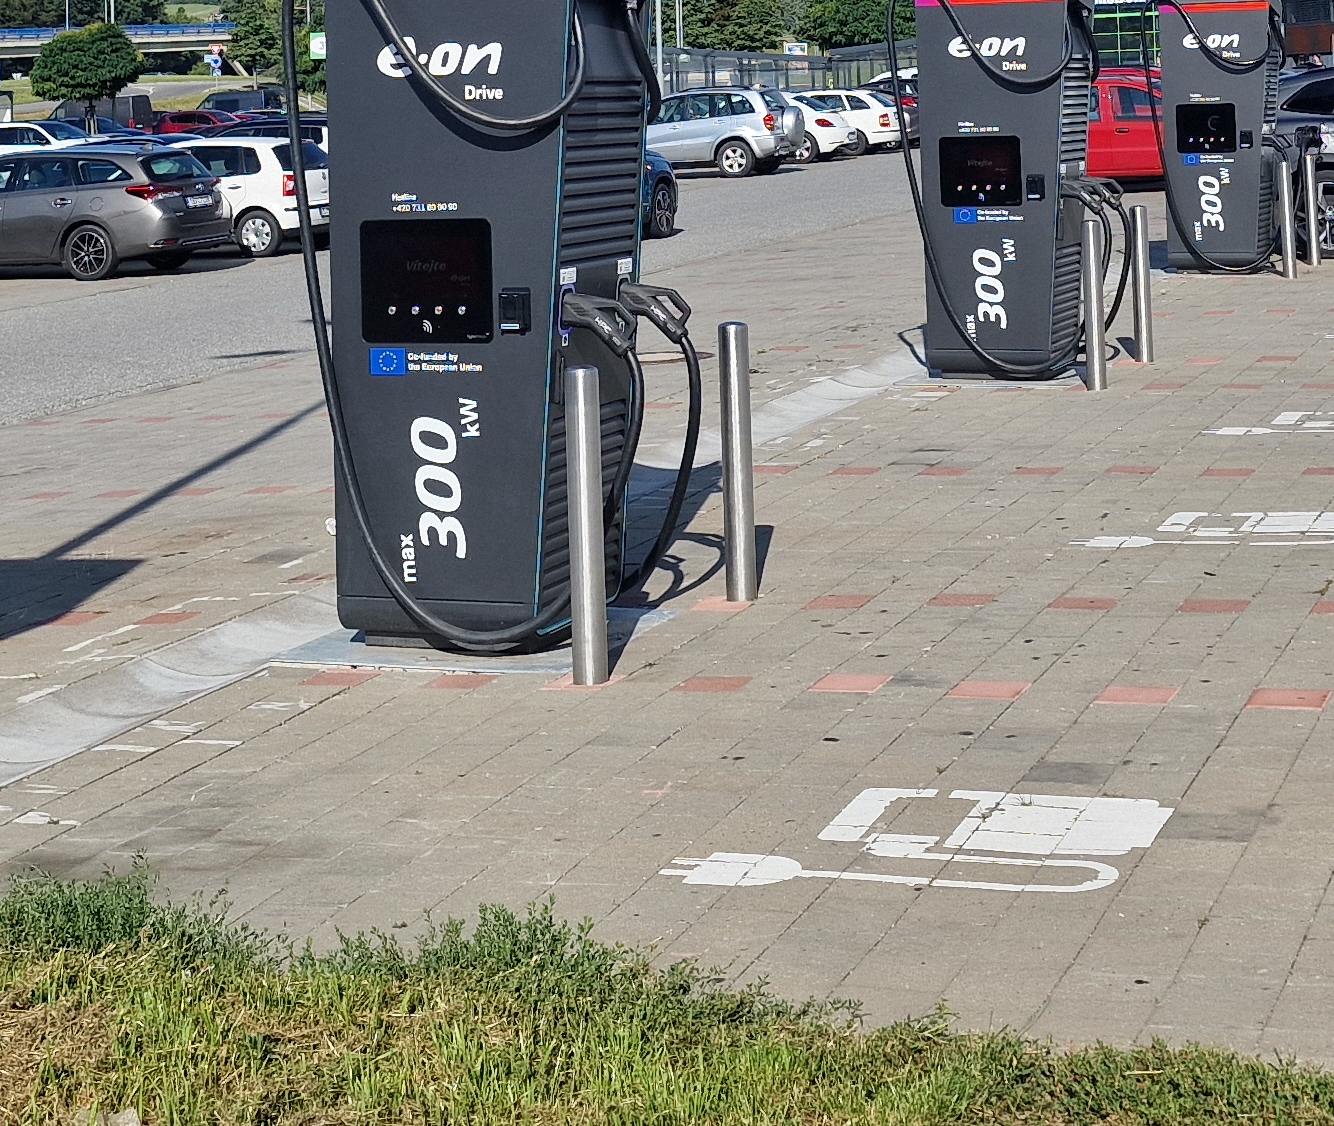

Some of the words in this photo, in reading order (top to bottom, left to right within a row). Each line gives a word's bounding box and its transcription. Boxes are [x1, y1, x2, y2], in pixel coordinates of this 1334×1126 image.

[1002, 61, 1028, 71] Drive
[465, 84, 504, 100] Drive
[1198, 175, 1225, 232] 300
[1001, 238, 1017, 262] kW
[972, 248, 1007, 329] 300
[407, 352, 447, 361] Co-funded
[449, 352, 458, 363] by
[407, 363, 420, 372] the
[422, 363, 458, 373] European
[460, 363, 483, 372] Union
[458, 397, 481, 437] kW
[410, 416, 467, 559] 300
[400, 532, 417, 583] max
